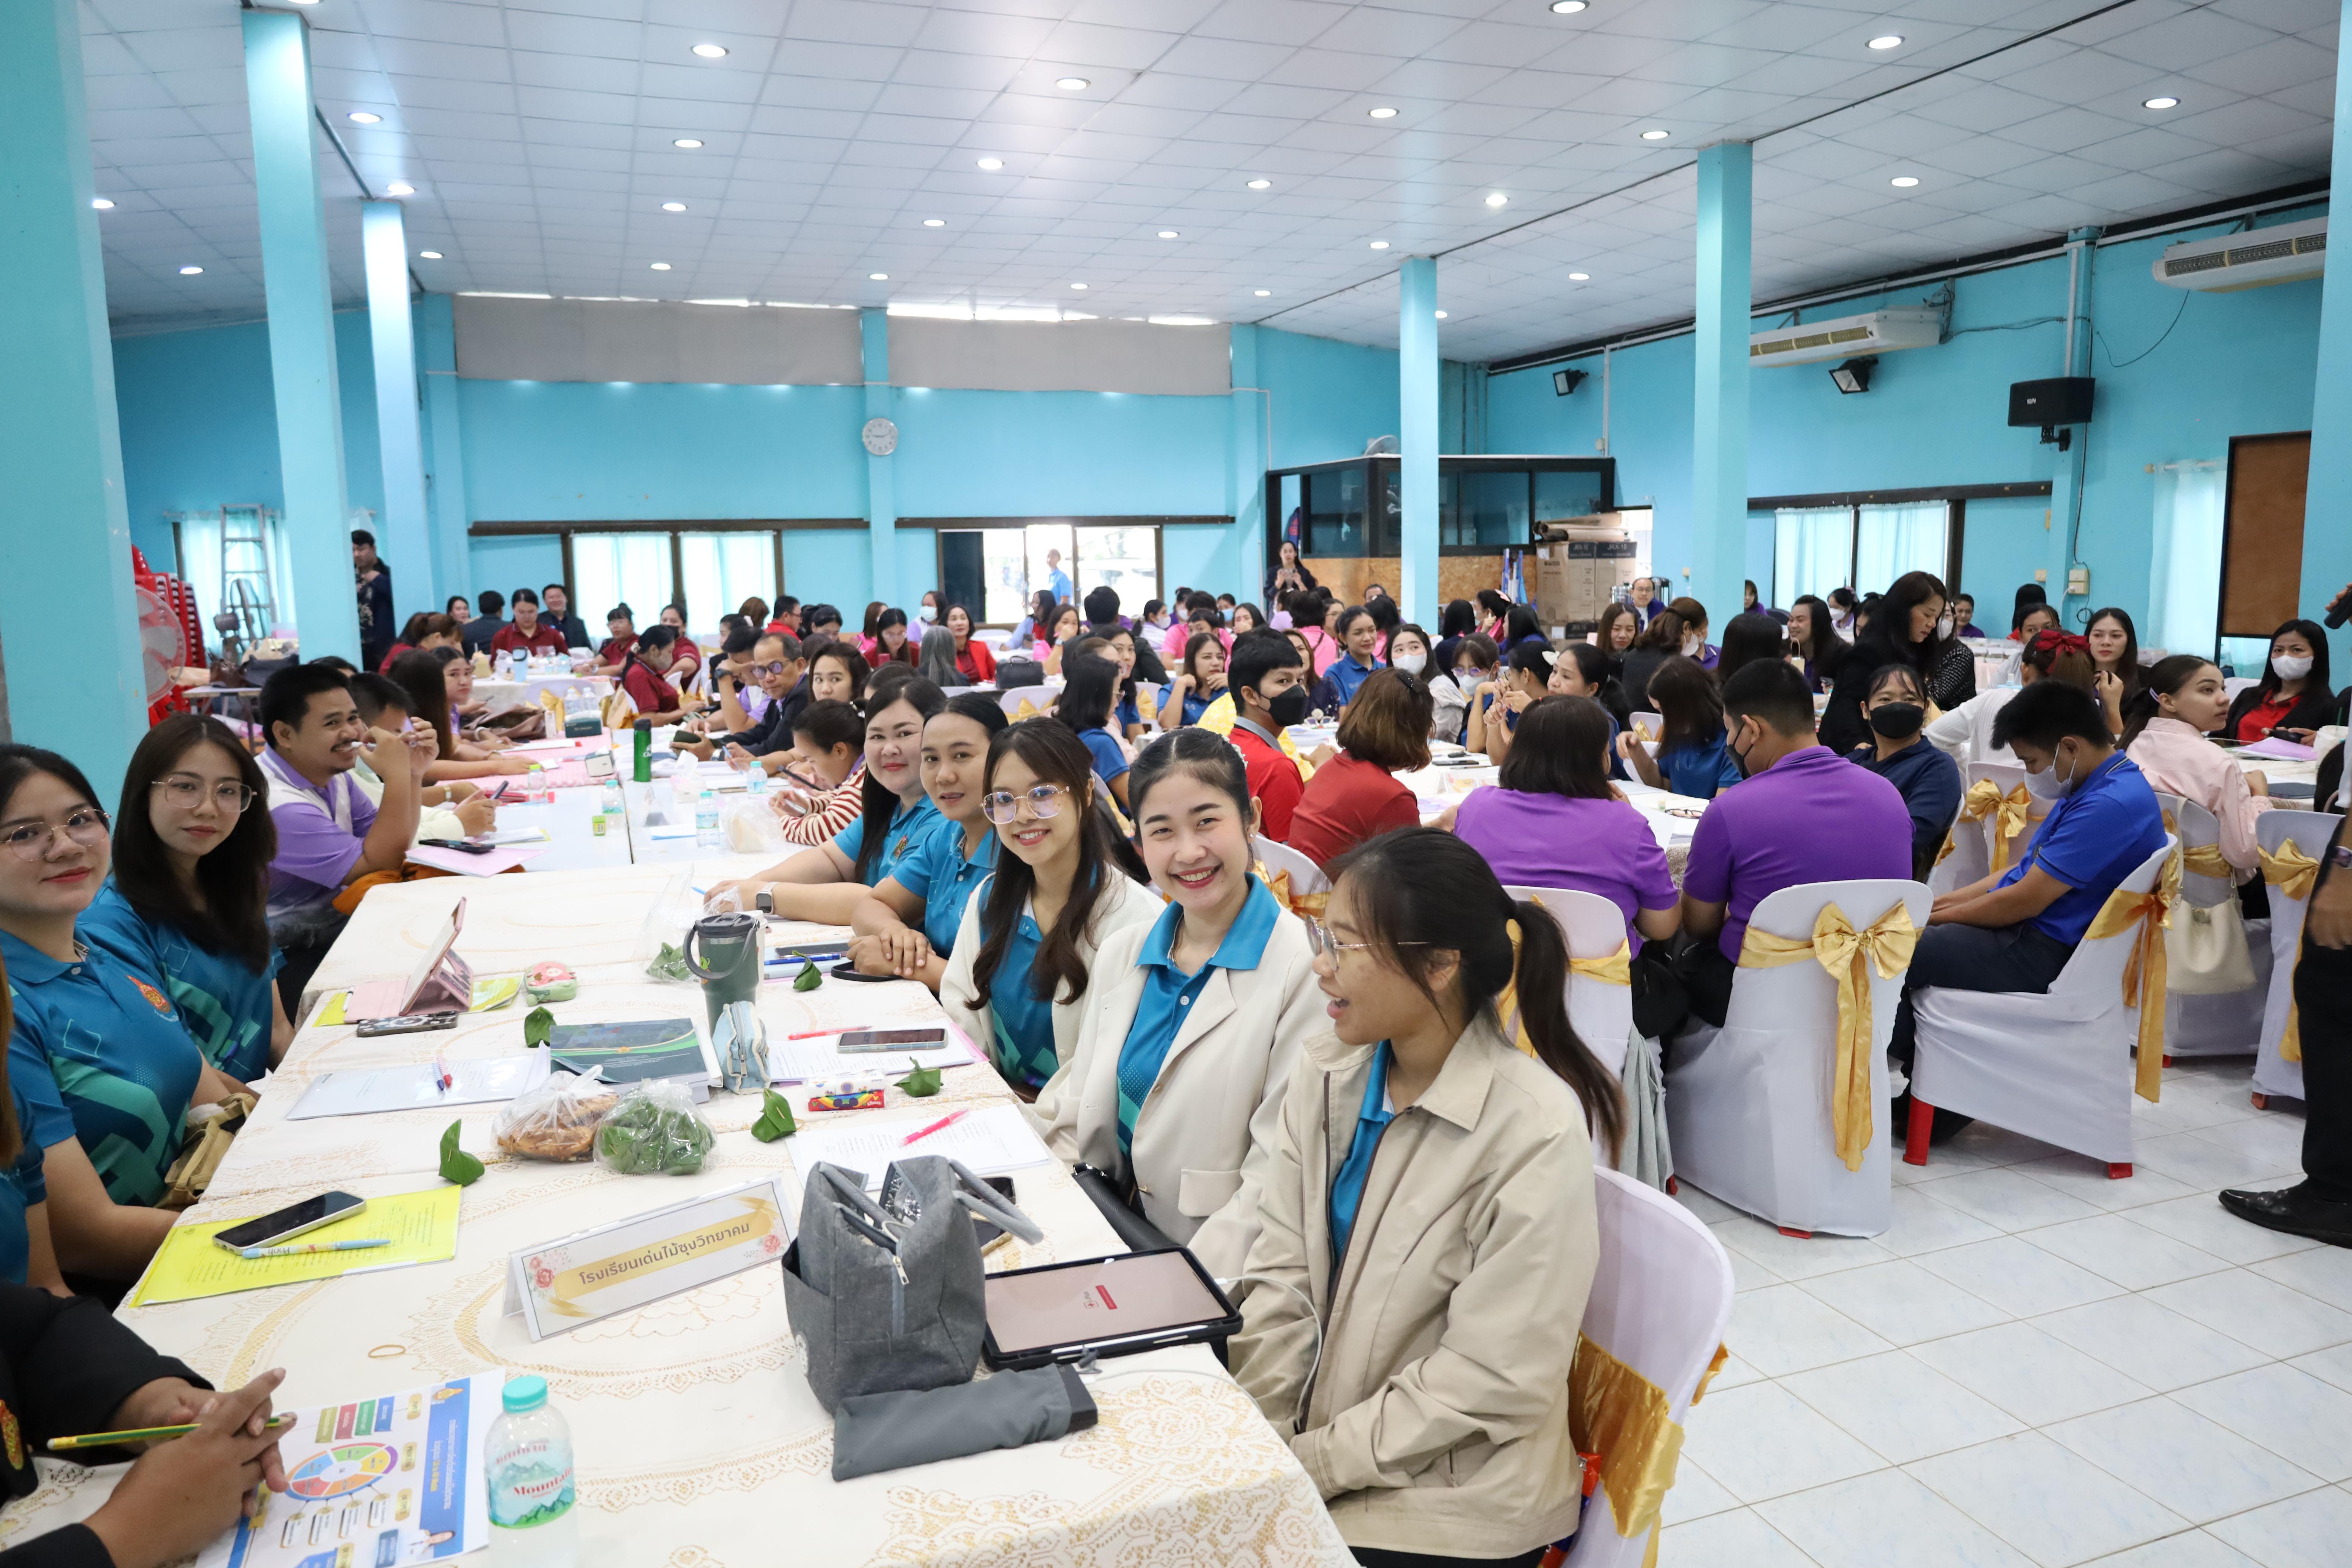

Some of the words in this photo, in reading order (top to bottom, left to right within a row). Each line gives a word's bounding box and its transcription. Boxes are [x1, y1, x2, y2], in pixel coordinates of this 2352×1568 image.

[268, 1247, 289, 1256] Pooh
[579, 1223, 750, 1285] โรงเรียนเด่นไม้ซุงวิทยาคม
